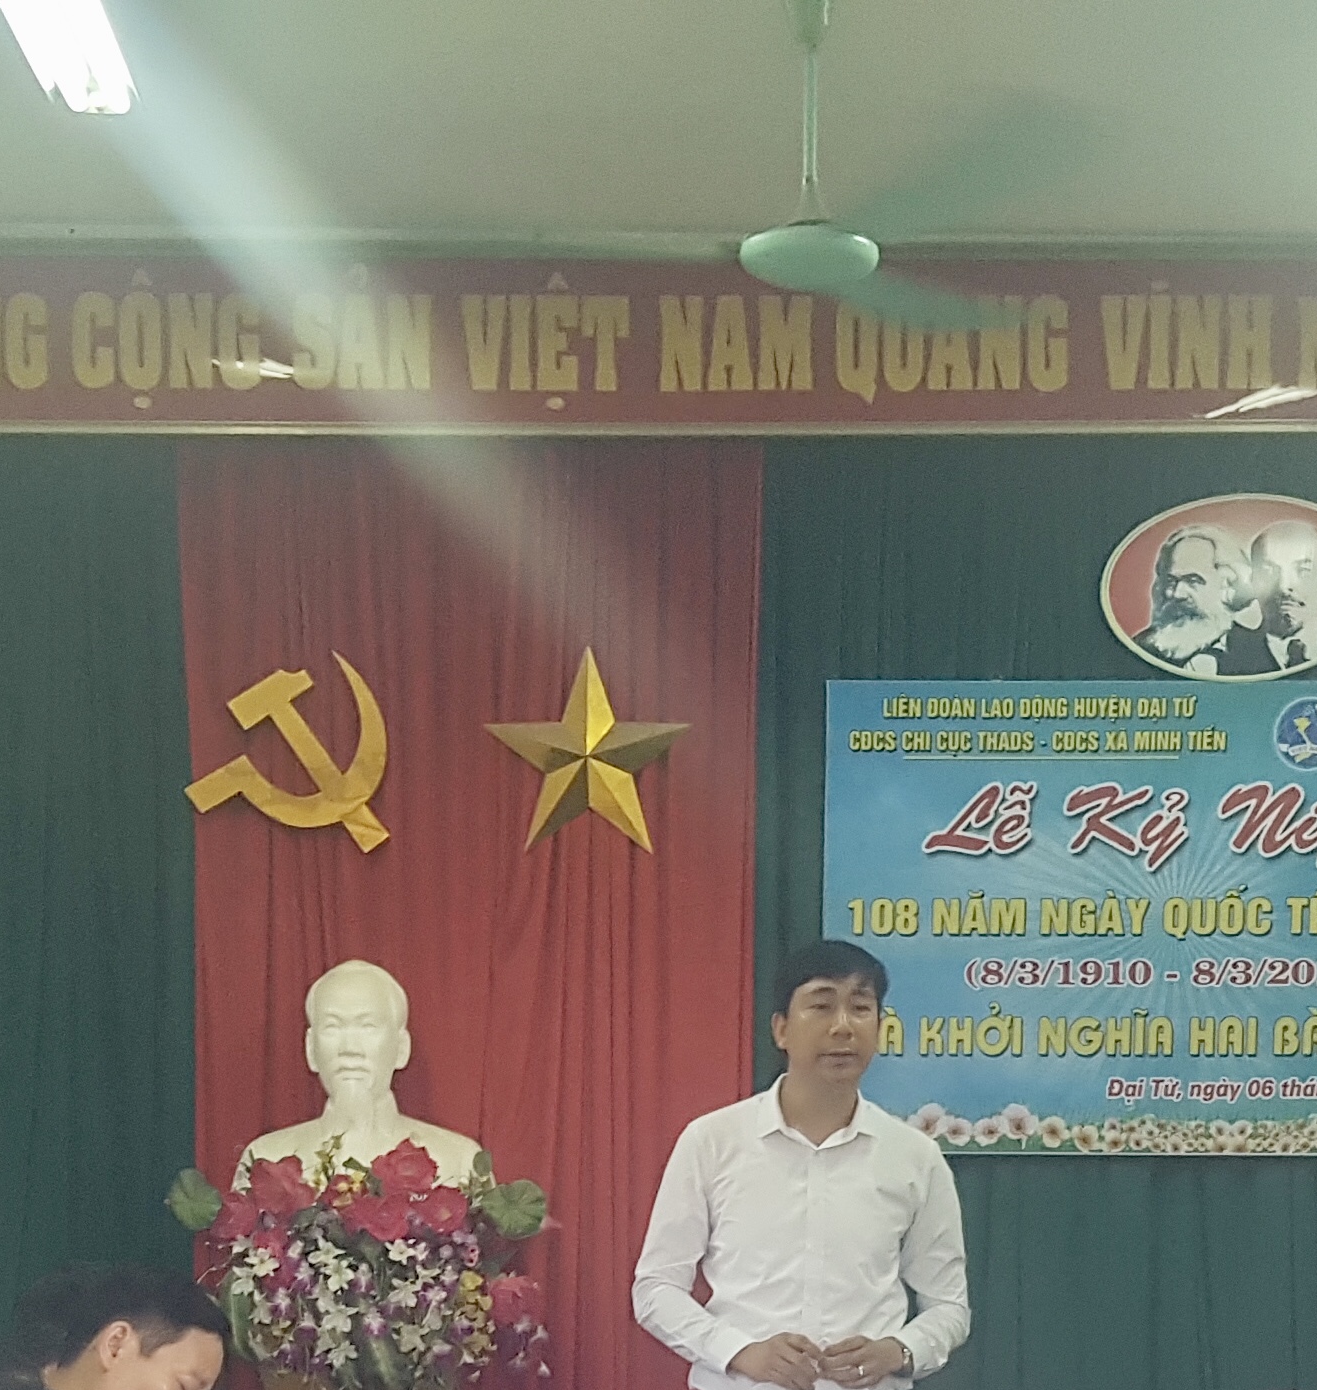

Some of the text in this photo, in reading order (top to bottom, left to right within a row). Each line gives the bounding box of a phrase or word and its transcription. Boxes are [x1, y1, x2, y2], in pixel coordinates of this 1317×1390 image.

[72, 268, 262, 409] CỘNG
[293, 263, 432, 390] SẢN
[461, 272, 630, 410] VIỆT
[659, 294, 814, 392] NAM
[835, 294, 1069, 405] QUANG
[1100, 279, 1274, 389] VĨNH
[883, 693, 923, 719] LIÊN
[927, 694, 976, 719] ĐOÀN
[981, 698, 1015, 719] LAO
[1019, 694, 1069, 723] ĐỘNG
[1073, 694, 1132, 723] HUYỆN
[1137, 697, 1167, 723] ĐẠI
[901, 731, 932, 751] CHI
[977, 731, 1034, 752] THADS
[1104, 727, 1129, 751] XÃ
[1133, 730, 1182, 751] MINH
[1187, 724, 1229, 751] TIẾN
[923, 781, 1039, 854] Lễ
[1063, 781, 1189, 872] Kỷ
[847, 898, 919, 936] 108
[932, 889, 1027, 936] NĂM
[1040, 889, 1151, 936] NGÀY
[1162, 884, 1273, 940] QUỐC
[964, 957, 1153, 989] (8/3/1910
[878, 1005, 904, 1057] À
[919, 1001, 1023, 1057] KHỞI
[1037, 1007, 1174, 1057] NGHĨA
[1189, 1015, 1259, 1057] HAI
[1106, 1077, 1146, 1105] Đại
[1189, 1077, 1242, 1104] ngày
[1246, 1076, 1276, 1100] 06
